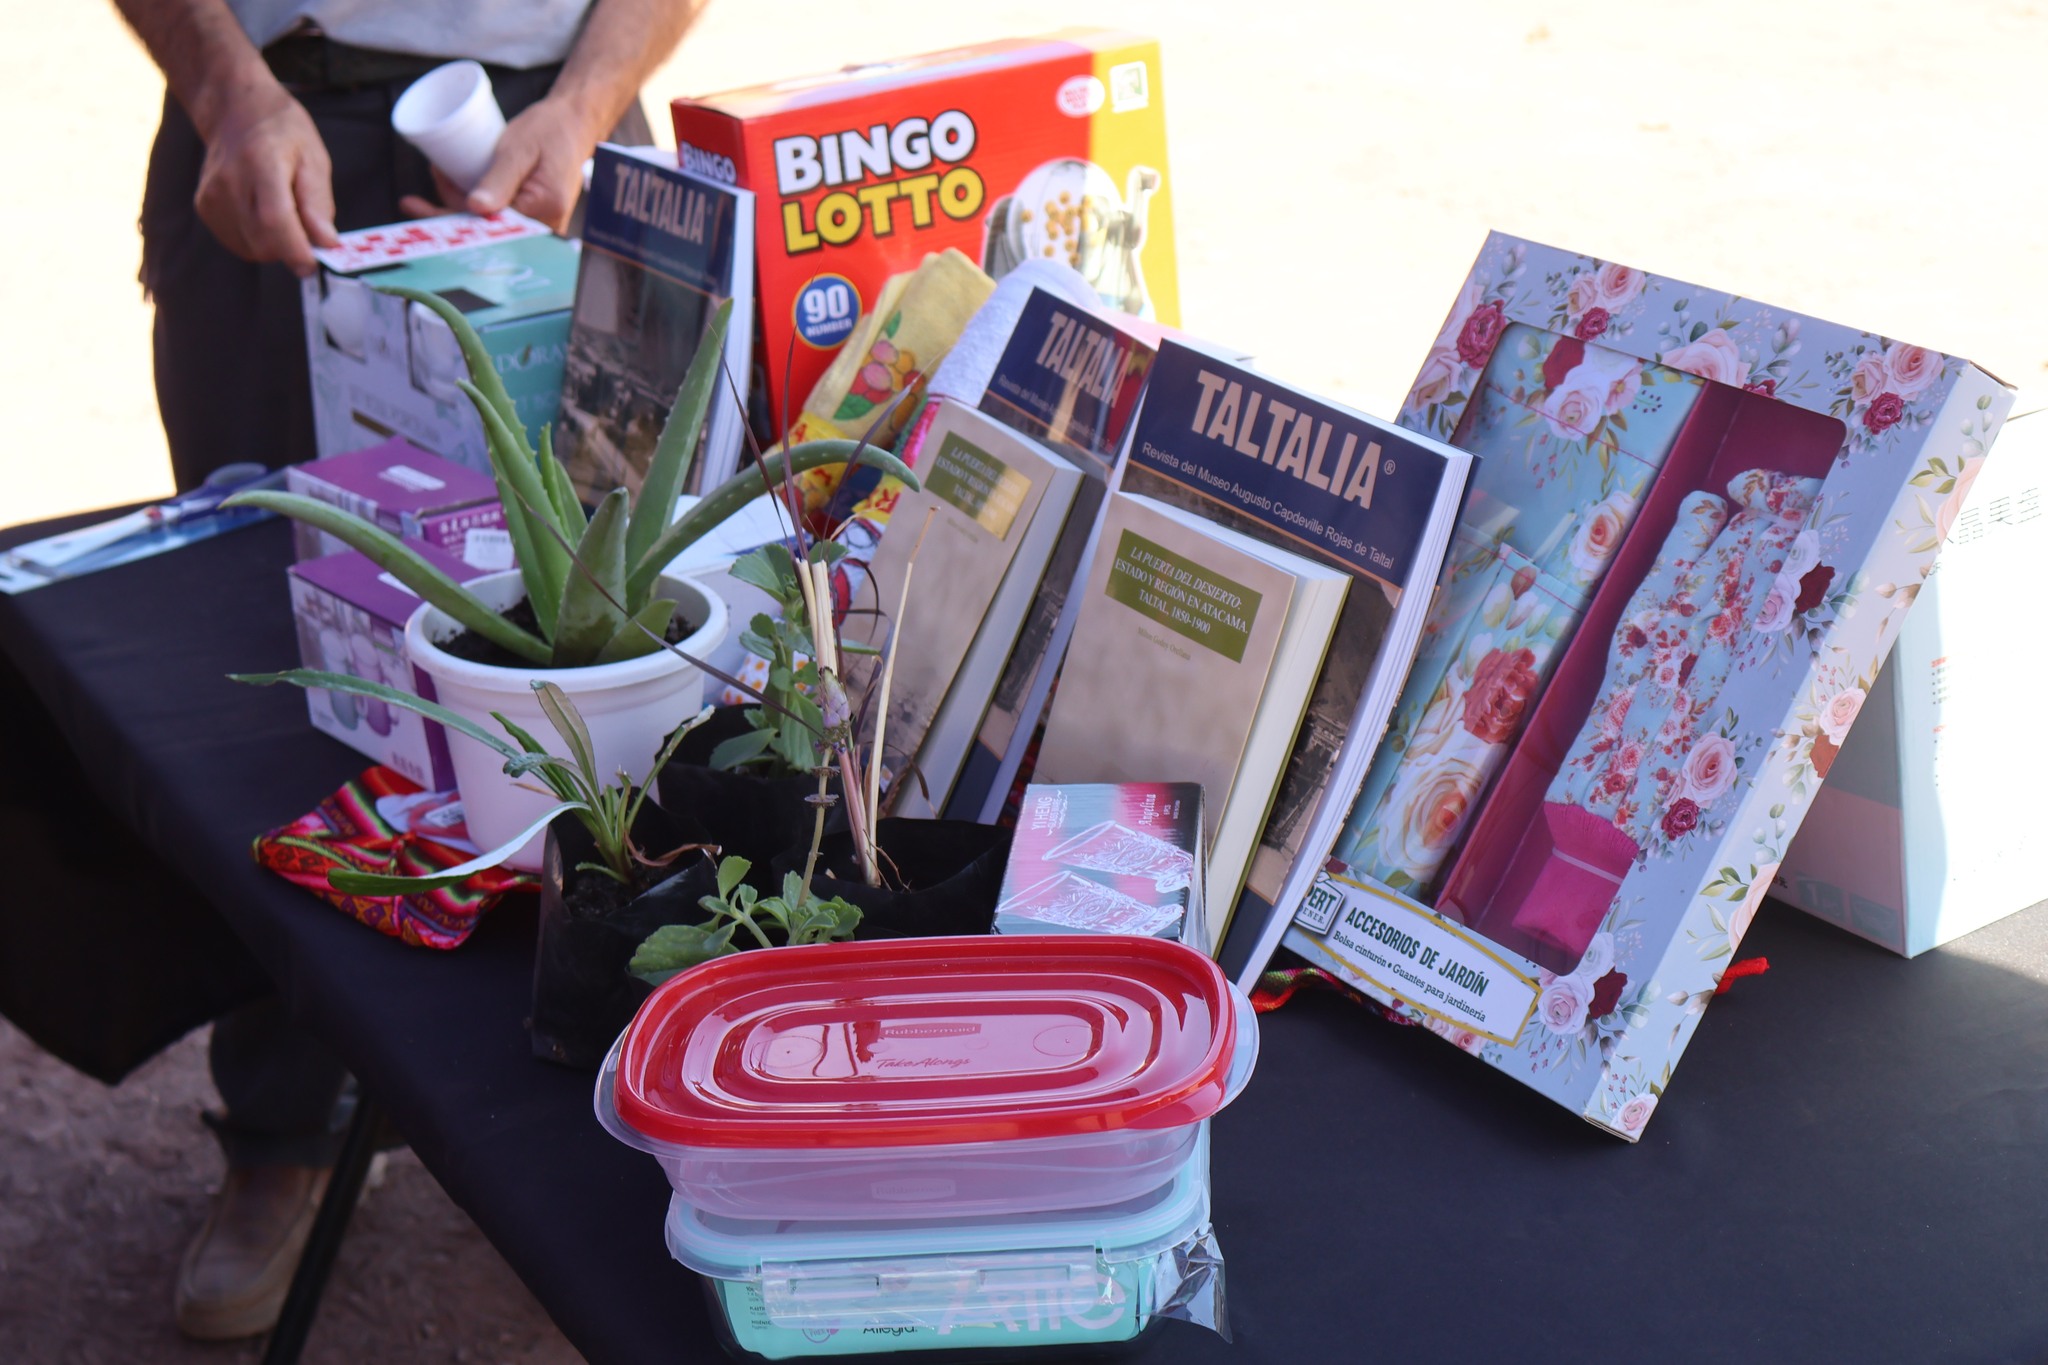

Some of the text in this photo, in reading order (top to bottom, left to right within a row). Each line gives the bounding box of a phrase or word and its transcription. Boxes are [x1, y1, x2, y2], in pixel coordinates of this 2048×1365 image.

[681, 141, 737, 184] BINGO
[773, 109, 977, 197] BINGO
[781, 166, 986, 256] LOTTO
[803, 284, 850, 324] 90
[806, 317, 853, 337] NUMBER
[1142, 441, 1395, 570] Revista del Museo Augusto Capdeville Rojas de Taltal
[1115, 557, 1248, 634] ESTADO Y REGIÓN EN ATACAMA.
[1130, 546, 1242, 611] LA PUERTA DEL DESIERTO:
[1171, 605, 1211, 635] 1850-1900
[1333, 930, 1487, 1022] Bolsa cinturón Guantes para jardinería
[1345, 906, 1489, 997] ACCESORIOS DE JARDÍN
